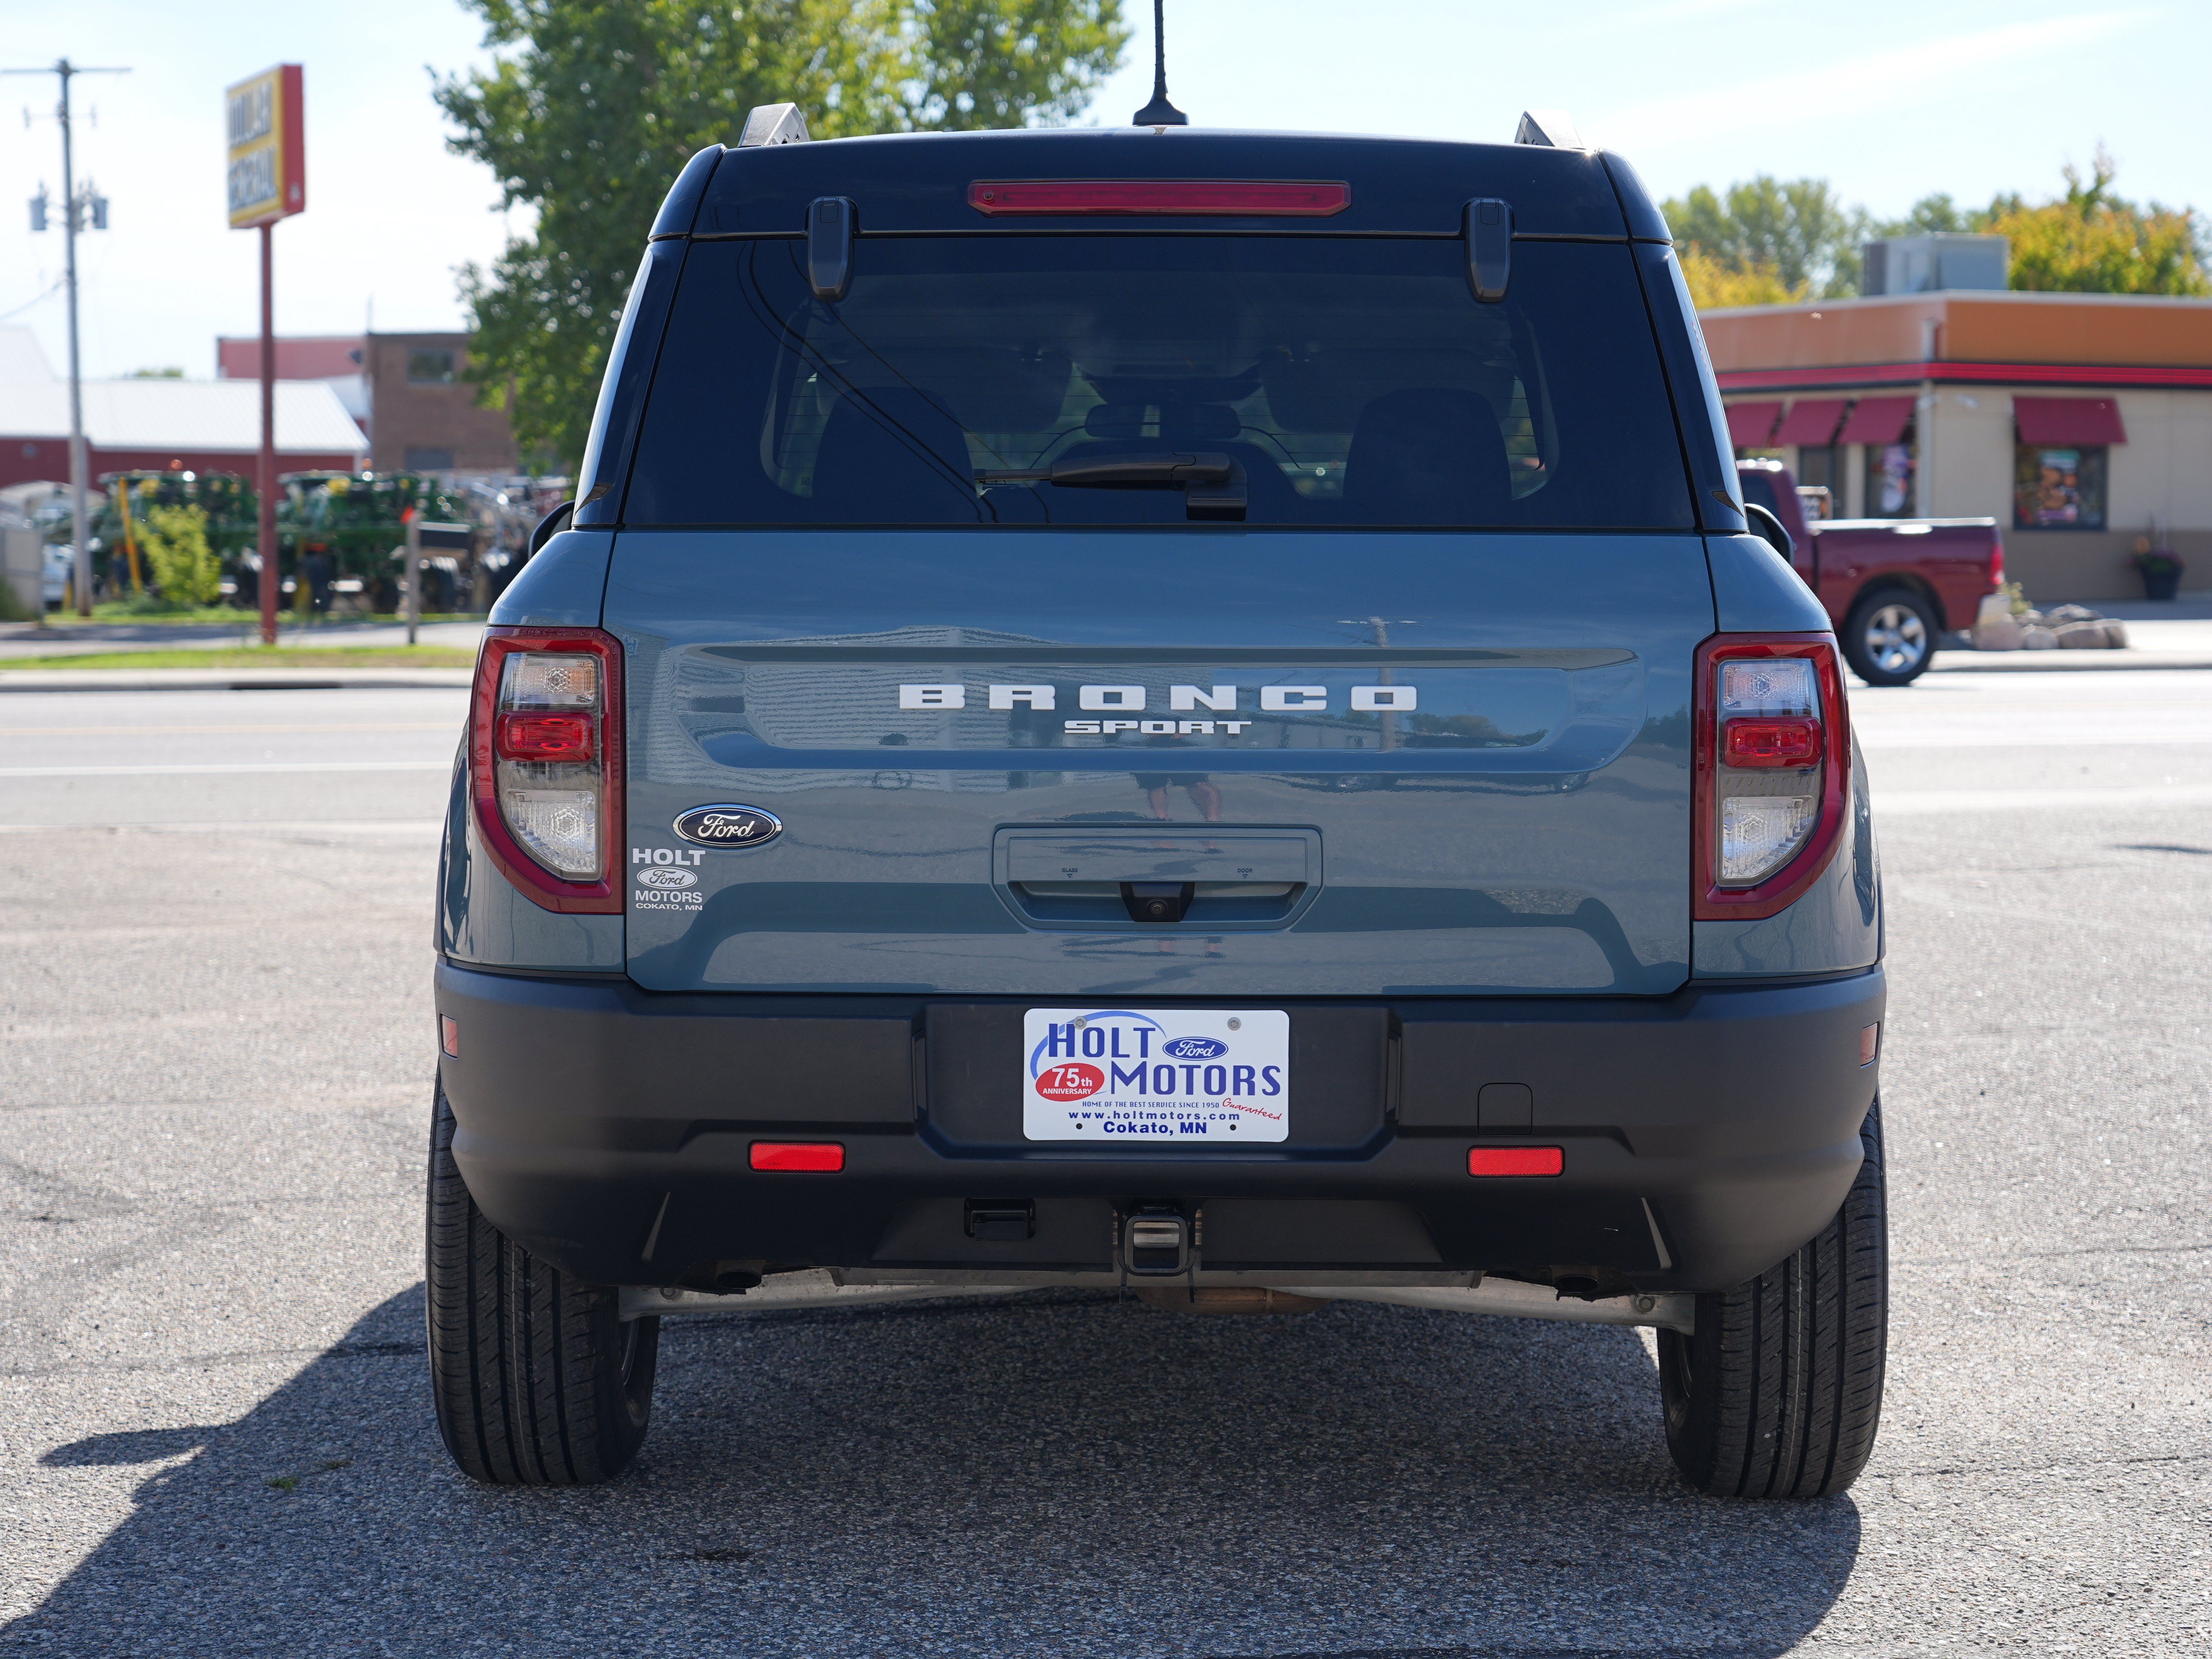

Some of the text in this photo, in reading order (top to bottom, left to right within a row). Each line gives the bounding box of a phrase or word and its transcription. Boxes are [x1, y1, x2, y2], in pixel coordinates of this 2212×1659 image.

[899, 684, 1417, 711] BRONCO
[1064, 720, 1252, 734] SPORT
[698, 814, 756, 838] Ford
[632, 848, 706, 866] HOLT
[649, 869, 685, 886] Ford
[635, 890, 703, 903] MOTORS
[636, 903, 682, 911] COKATO,
[1049, 1023, 1156, 1058] HOLT
[1175, 1040, 1216, 1057] Ford
[1052, 1068, 1092, 1087] 75th
[1111, 1061, 1281, 1096] MOTORS
[1069, 1110, 1240, 1120] www.holtmotors.com
[1222, 1097, 1282, 1121] Guaranteed
[1103, 1121, 1207, 1136] Cokato, MN
